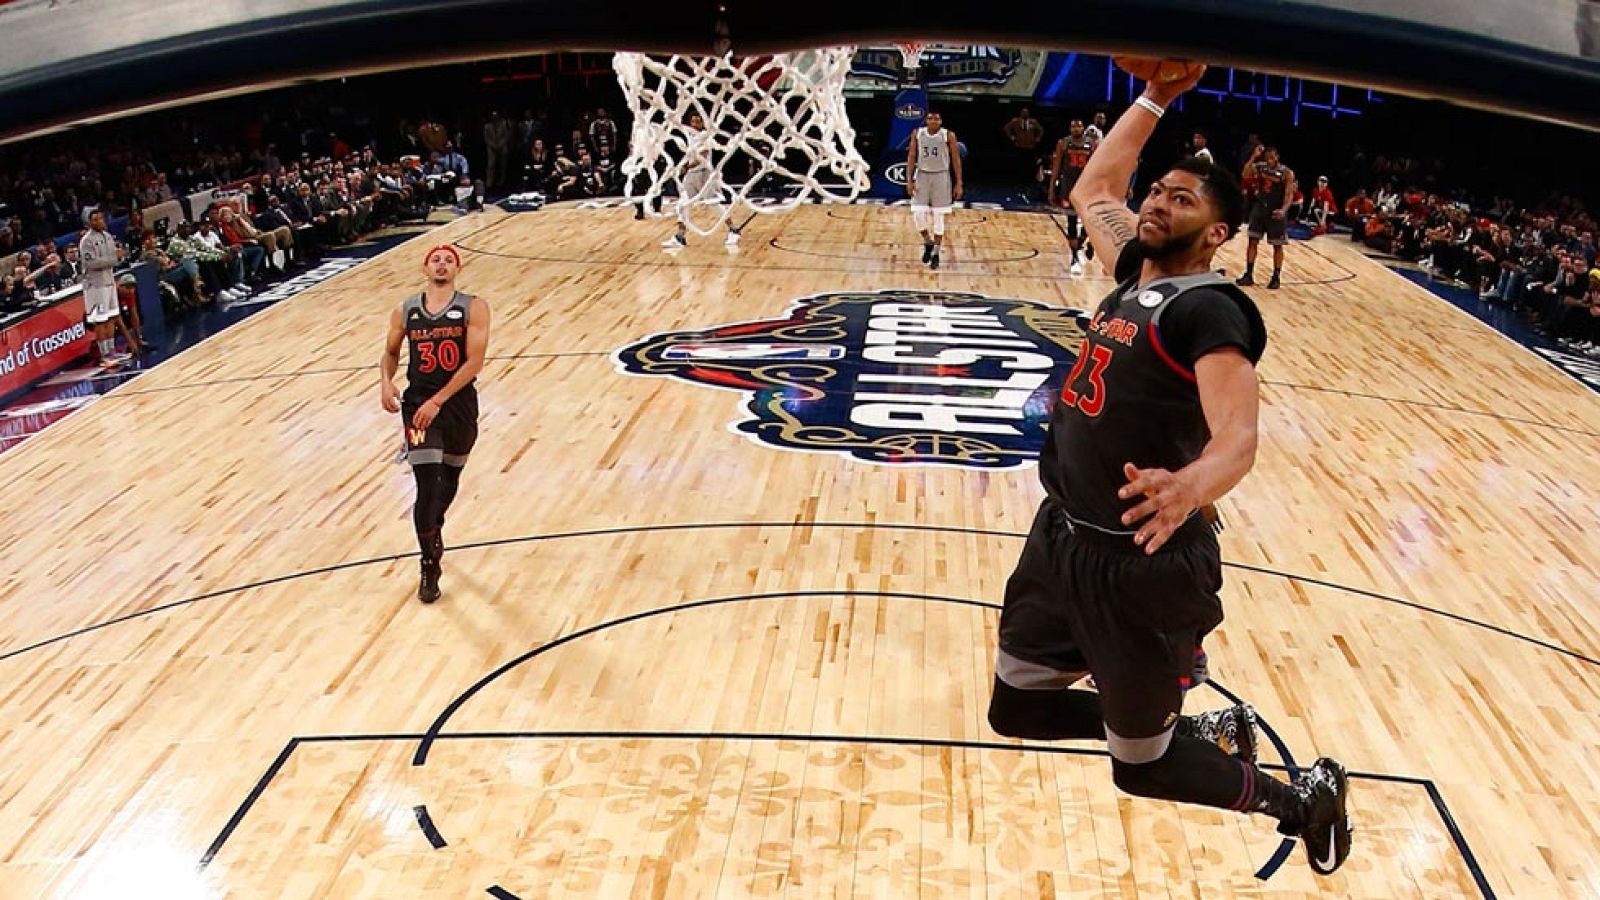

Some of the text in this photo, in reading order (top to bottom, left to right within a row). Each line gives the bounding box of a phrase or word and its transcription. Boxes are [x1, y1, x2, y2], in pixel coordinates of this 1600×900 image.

[922, 145, 938, 158] 34
[0, 322, 86, 375] nd of Crossover
[417, 339, 459, 373] 30
[850, 302, 1054, 435] ALL STAR
[1061, 338, 1113, 417] 23
